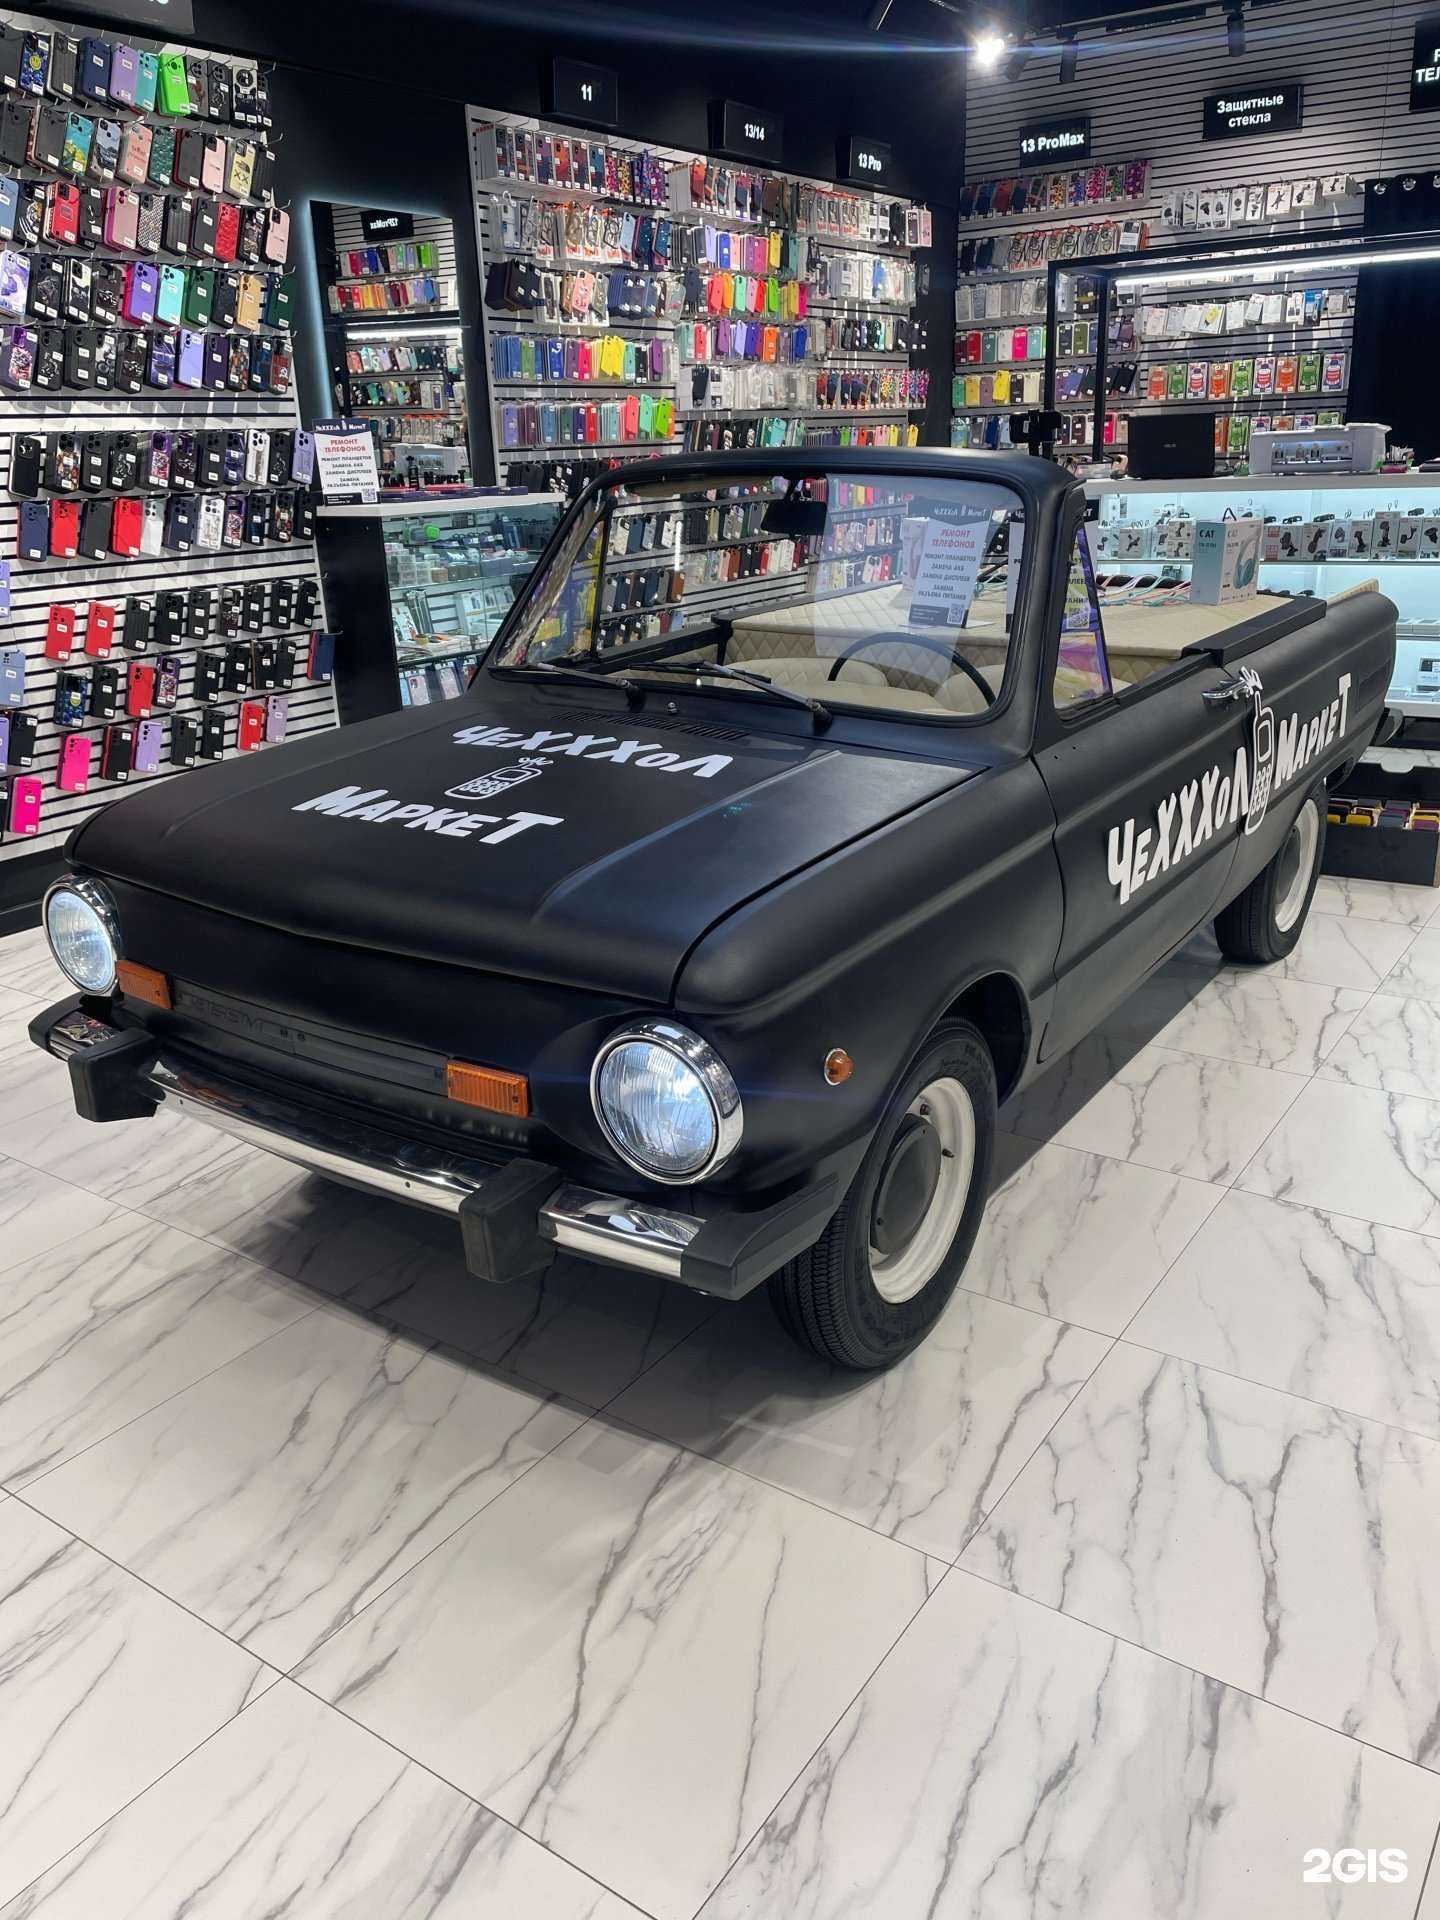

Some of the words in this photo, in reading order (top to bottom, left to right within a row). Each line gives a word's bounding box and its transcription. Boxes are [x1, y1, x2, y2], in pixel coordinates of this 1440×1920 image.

[581, 84, 592, 101] 11
[1217, 94, 1284, 114] Защитные
[1228, 112, 1271, 128] стекла
[744, 123, 765, 141] 13/14
[1021, 139, 1035, 153] 13
[1038, 131, 1085, 151] ProMax
[858, 152, 867, 169] 13
[868, 155, 882, 172] Pro
[940, 529, 971, 538] РЕМОНТ
[1199, 529, 1216, 540] CAT
[932, 539, 976, 549] ТЕЛЕФОНОВ
